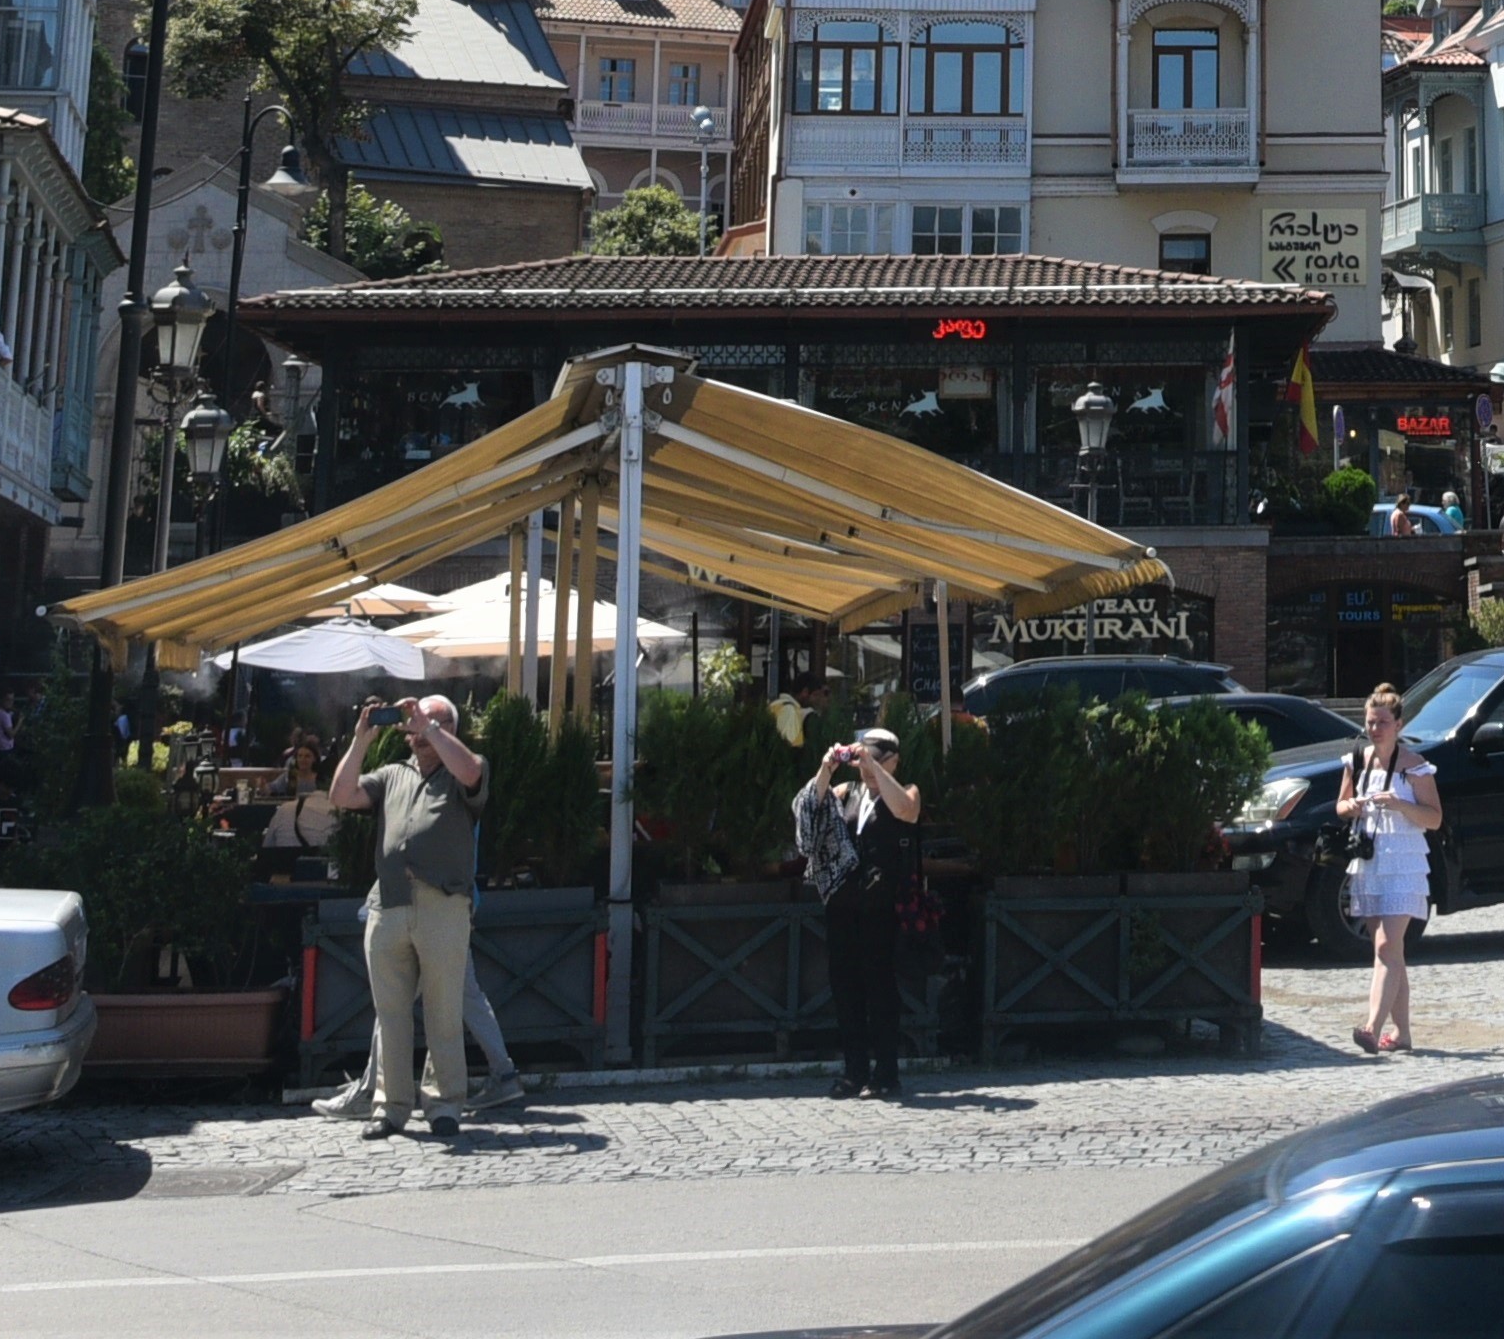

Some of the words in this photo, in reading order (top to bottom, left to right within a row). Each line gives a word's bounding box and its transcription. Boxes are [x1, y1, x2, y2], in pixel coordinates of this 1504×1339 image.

[1305, 251, 1360, 270] rasta
[1305, 272, 1360, 284] HOTEL
[1396, 416, 1451, 431] BAZAR
[1345, 591, 1366, 606] EU
[1337, 610, 1381, 622] TOURS
